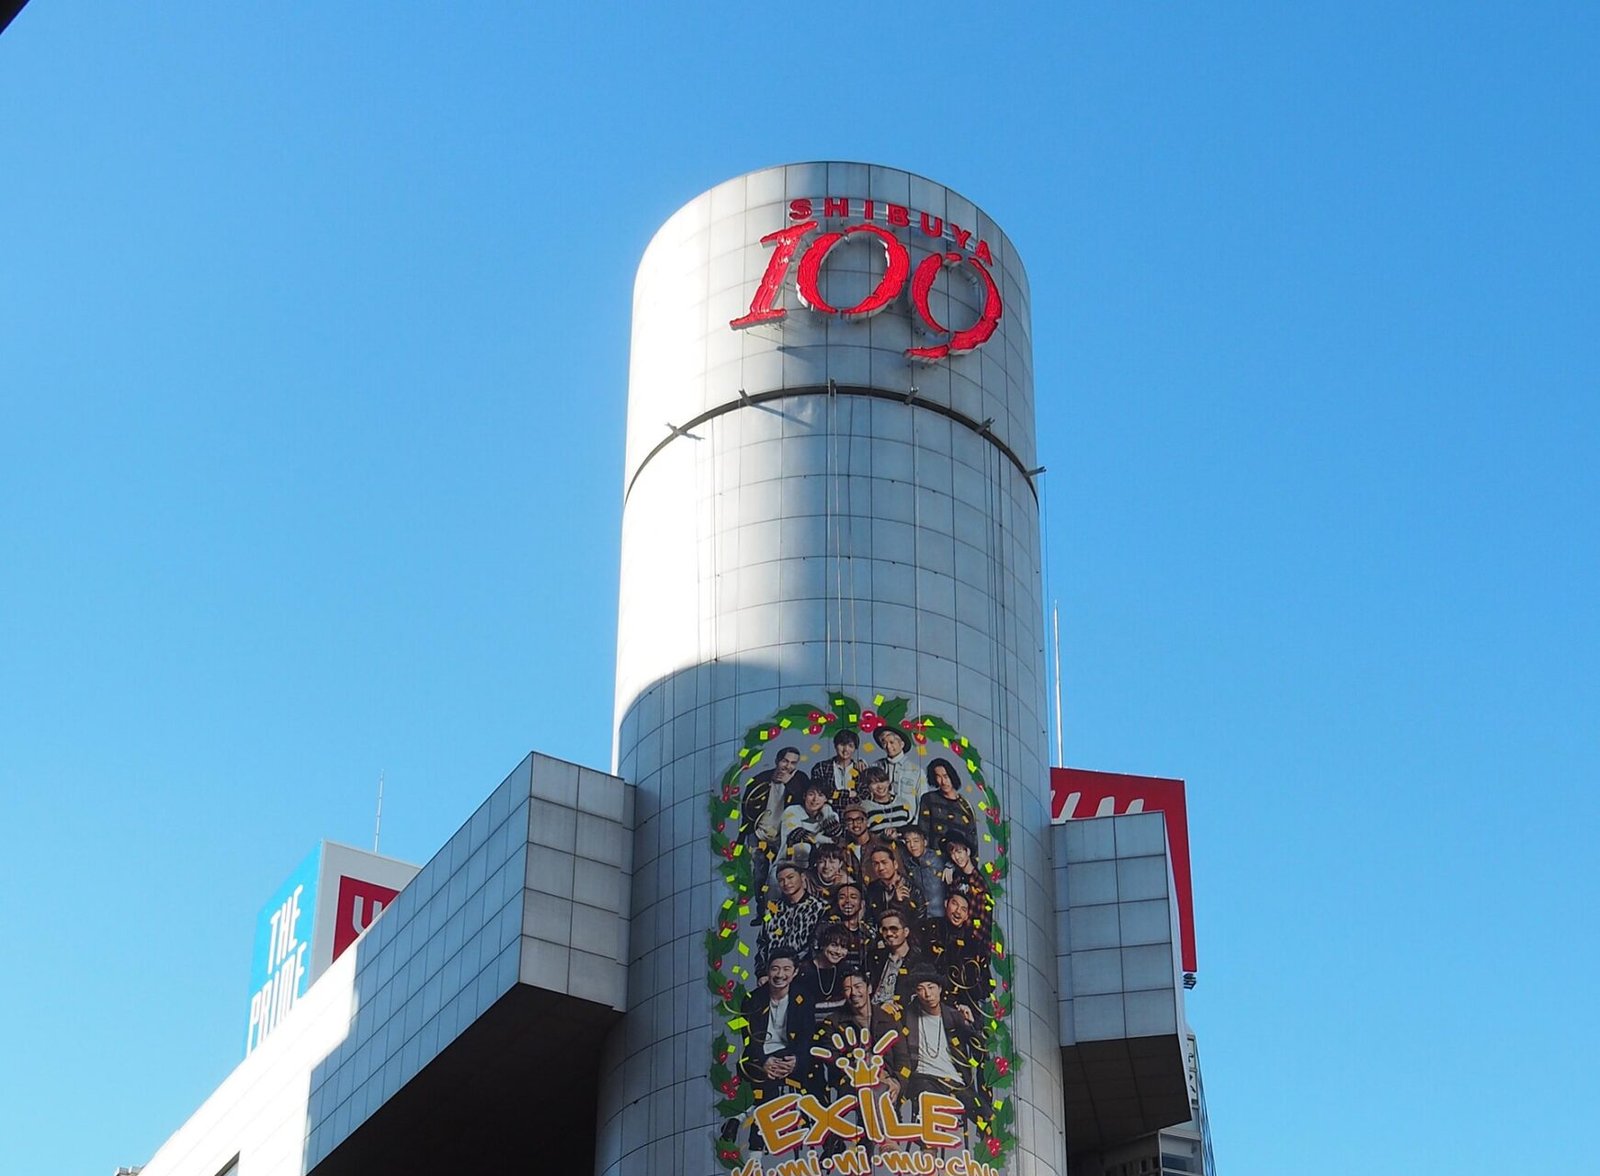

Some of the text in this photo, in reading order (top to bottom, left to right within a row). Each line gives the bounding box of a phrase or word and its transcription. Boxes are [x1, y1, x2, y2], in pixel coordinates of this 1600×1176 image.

[789, 197, 993, 266] SHIBUYA
[729, 220, 1003, 363] 109
[268, 884, 304, 975] THE
[753, 1087, 966, 1157] EXILE
